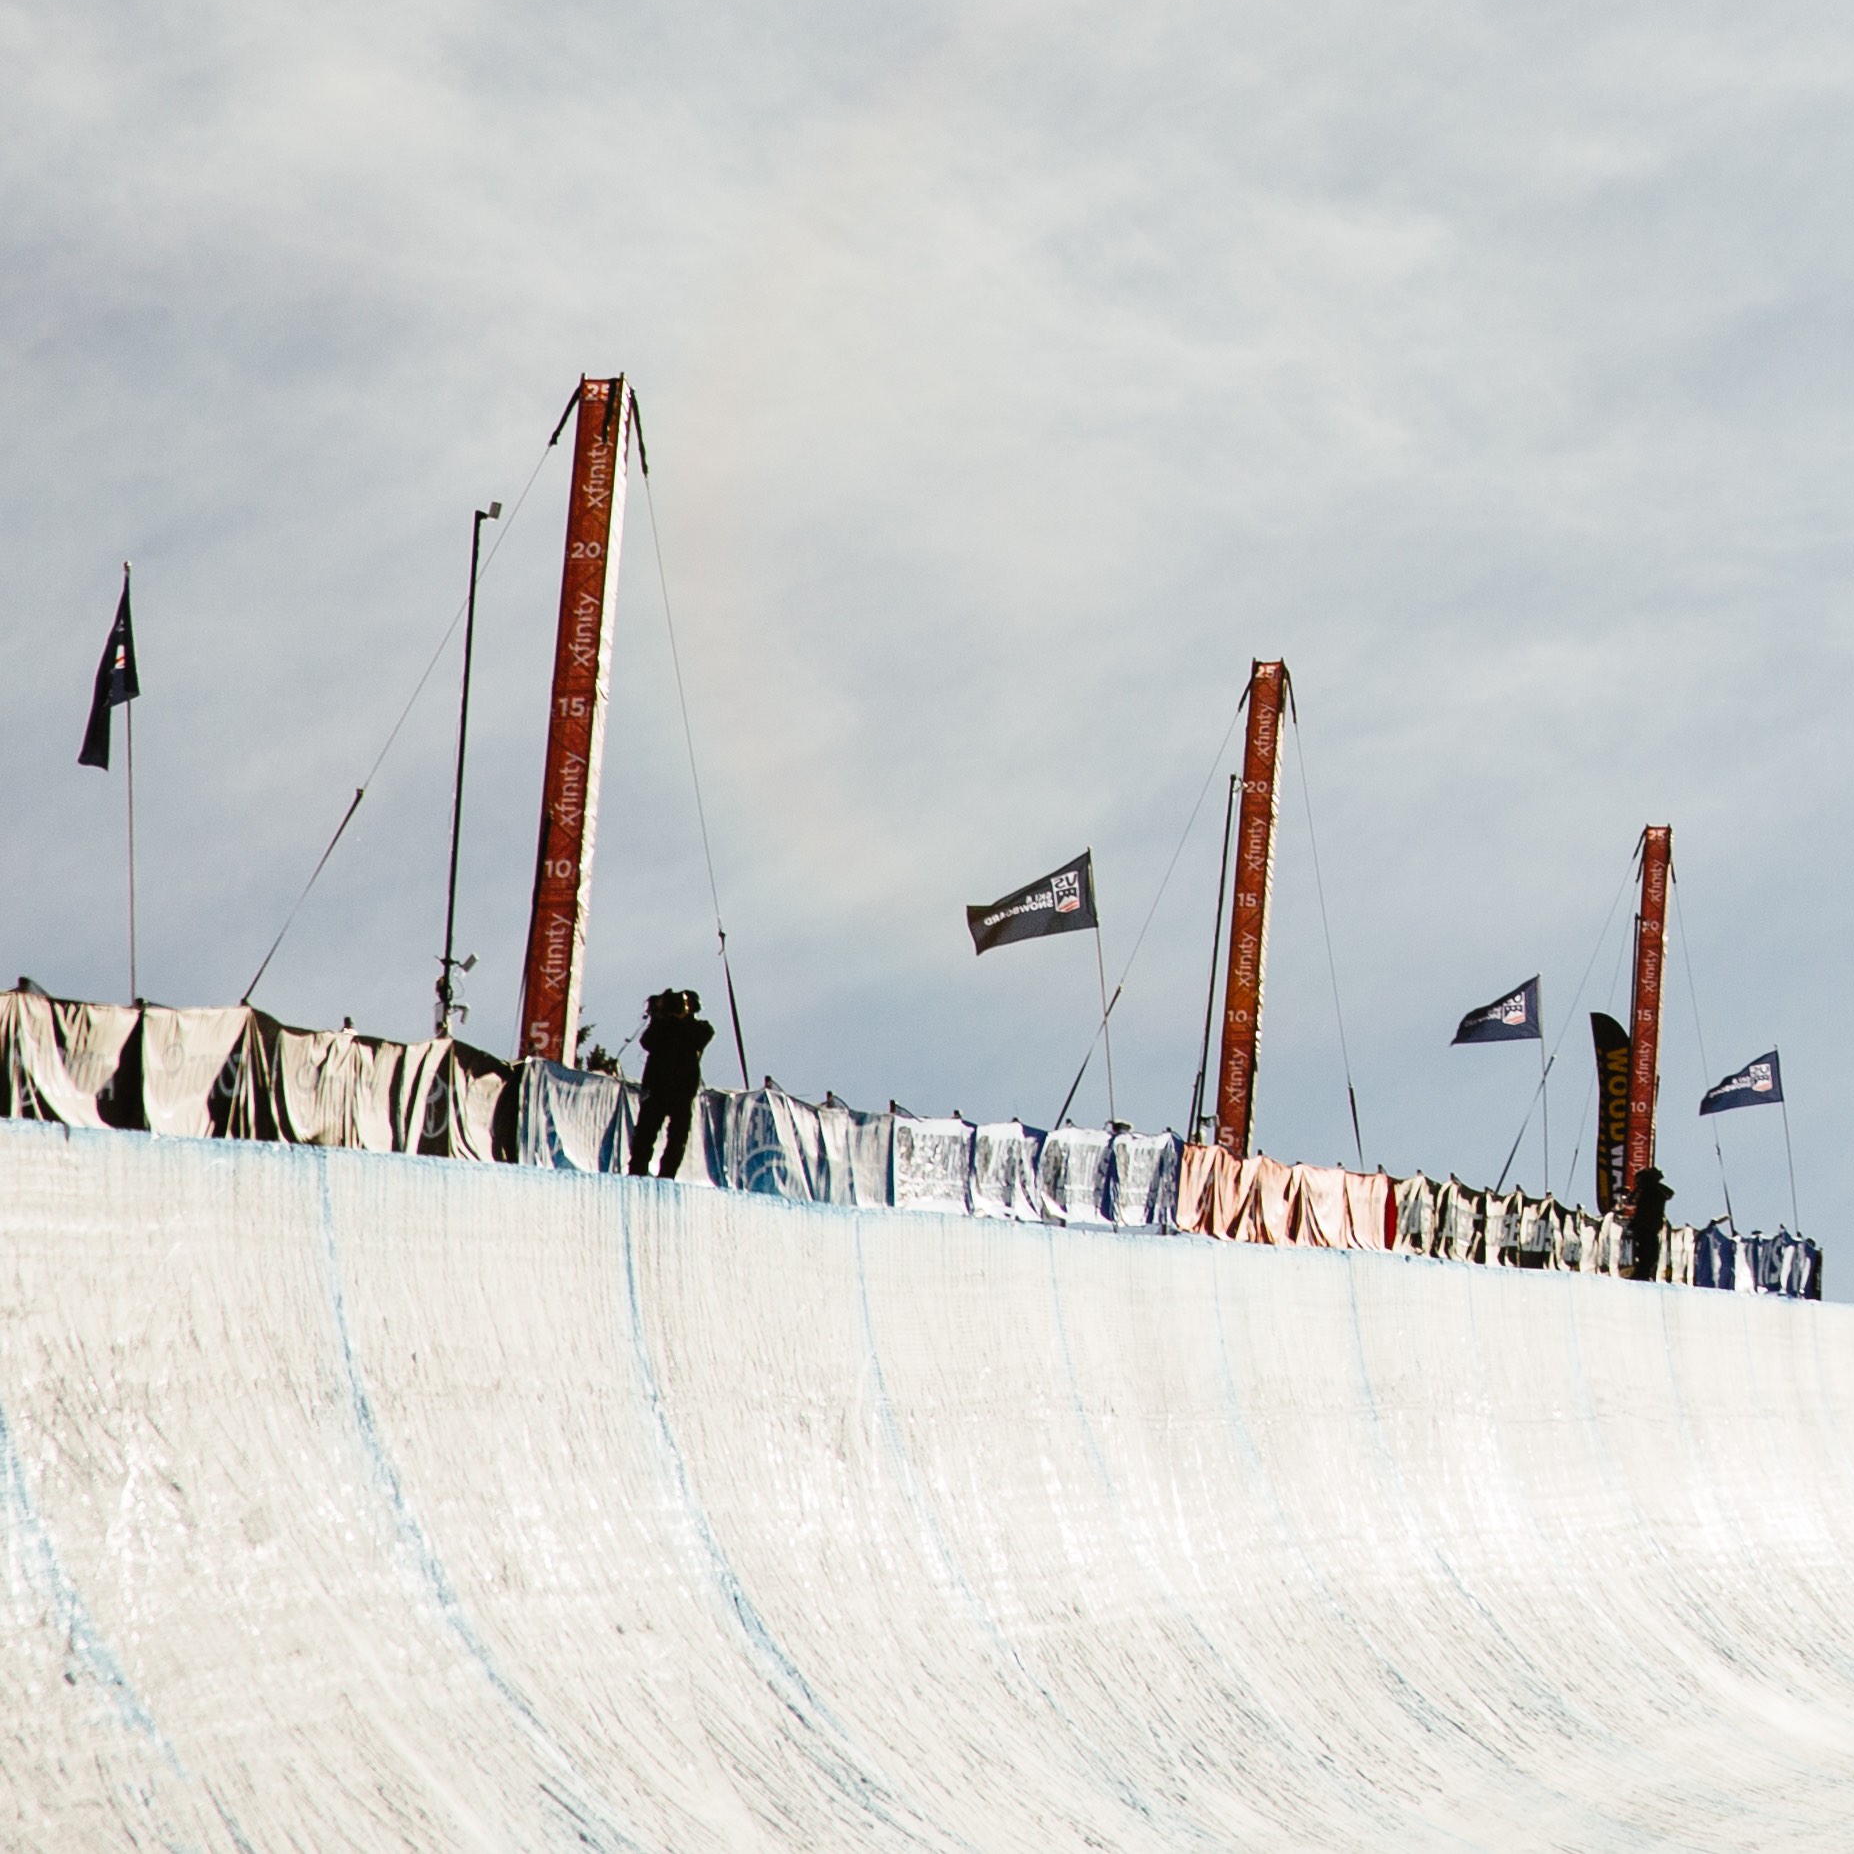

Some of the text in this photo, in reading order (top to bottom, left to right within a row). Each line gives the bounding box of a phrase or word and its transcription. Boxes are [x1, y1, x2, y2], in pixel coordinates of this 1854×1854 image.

[570, 541, 601, 560] 20
[568, 591, 600, 668] xfinity
[558, 697, 586, 718] 15
[1252, 702, 1277, 756] xfinity
[555, 750, 587, 828] xfinity
[1246, 780, 1268, 794] 20
[1244, 815, 1268, 871] xfinity
[544, 859, 572, 879] 10
[1647, 858, 1666, 903] xfinity
[1237, 893, 1257, 908] 15
[540, 911, 572, 990] xfinity
[1235, 931, 1258, 988] xfinity
[1640, 949, 1660, 993] xfinity
[529, 1021, 550, 1050] 5
[1226, 1009, 1248, 1023] 10
[1636, 1009, 1653, 1022] 15
[1225, 1047, 1249, 1104] xfinity
[1635, 1040, 1653, 1085] xfinity
[1630, 1101, 1648, 1113] 10
